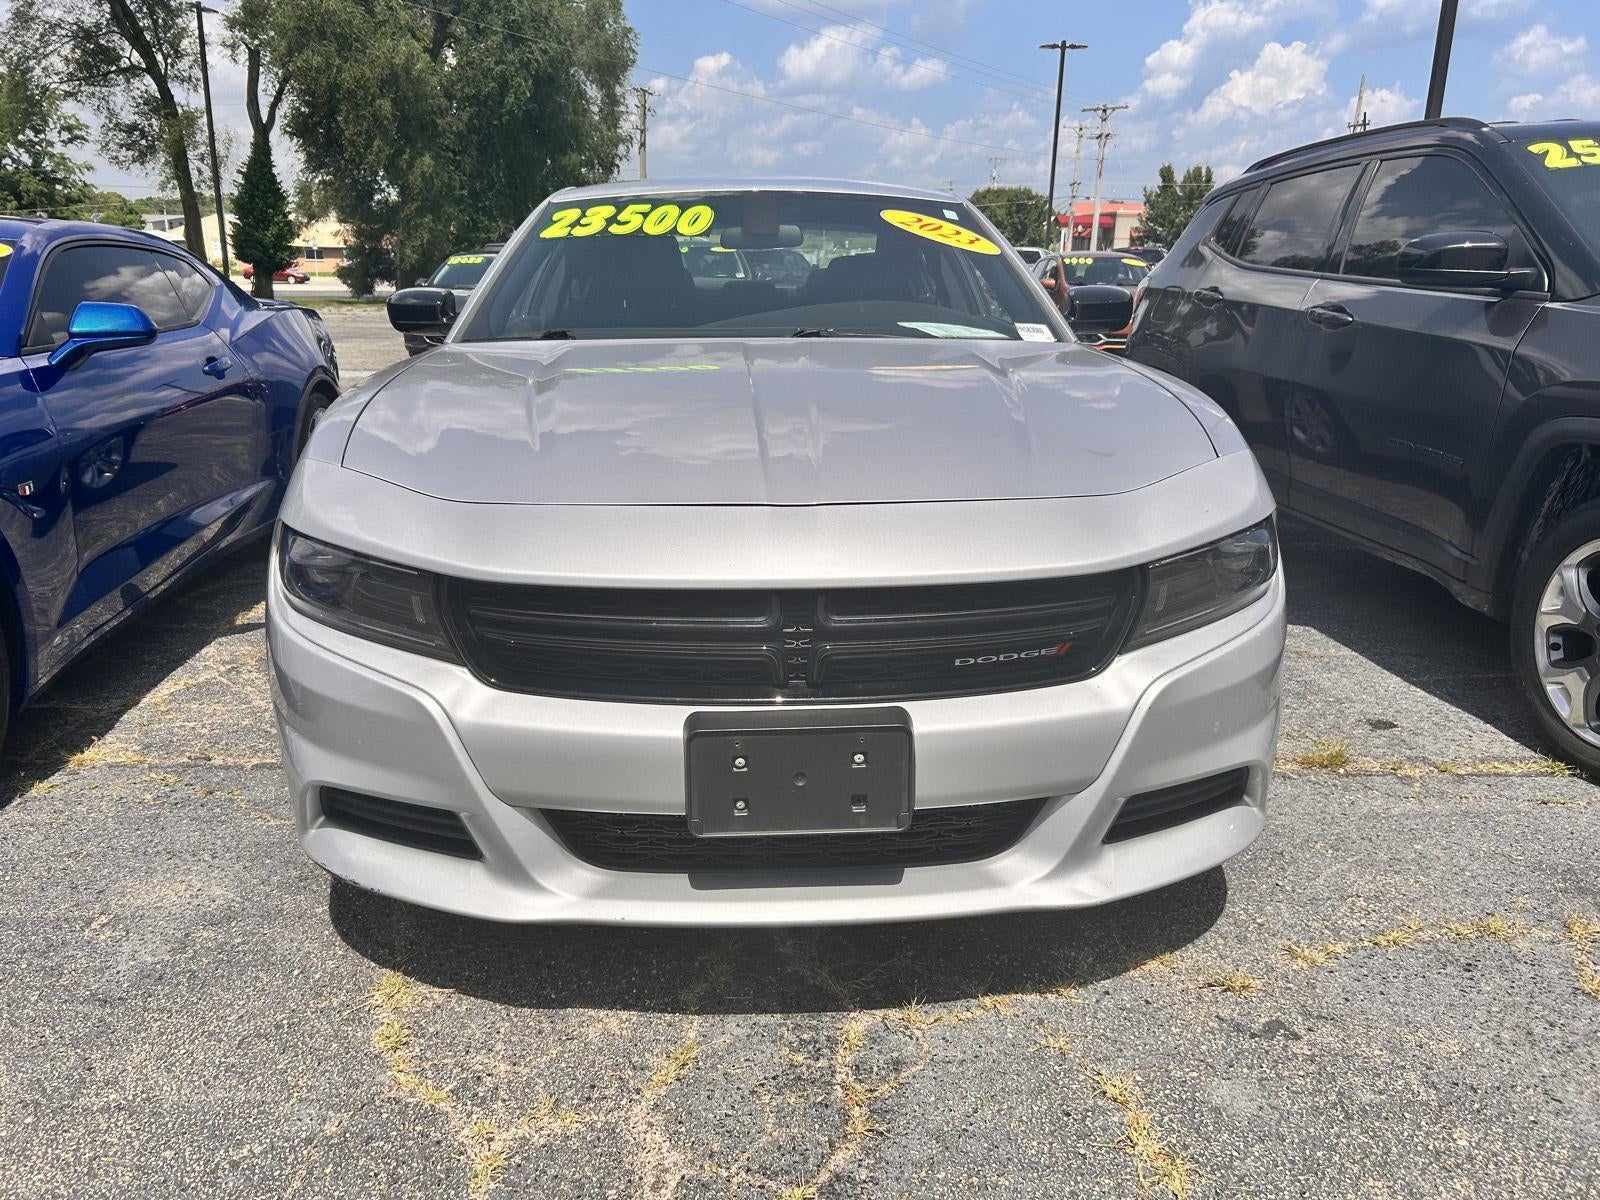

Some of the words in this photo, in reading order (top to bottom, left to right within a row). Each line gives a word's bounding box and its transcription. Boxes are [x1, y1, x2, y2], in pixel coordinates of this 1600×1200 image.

[539, 203, 715, 239] 23500
[897, 216, 981, 245] 2023
[954, 646, 1060, 666] DODGE
